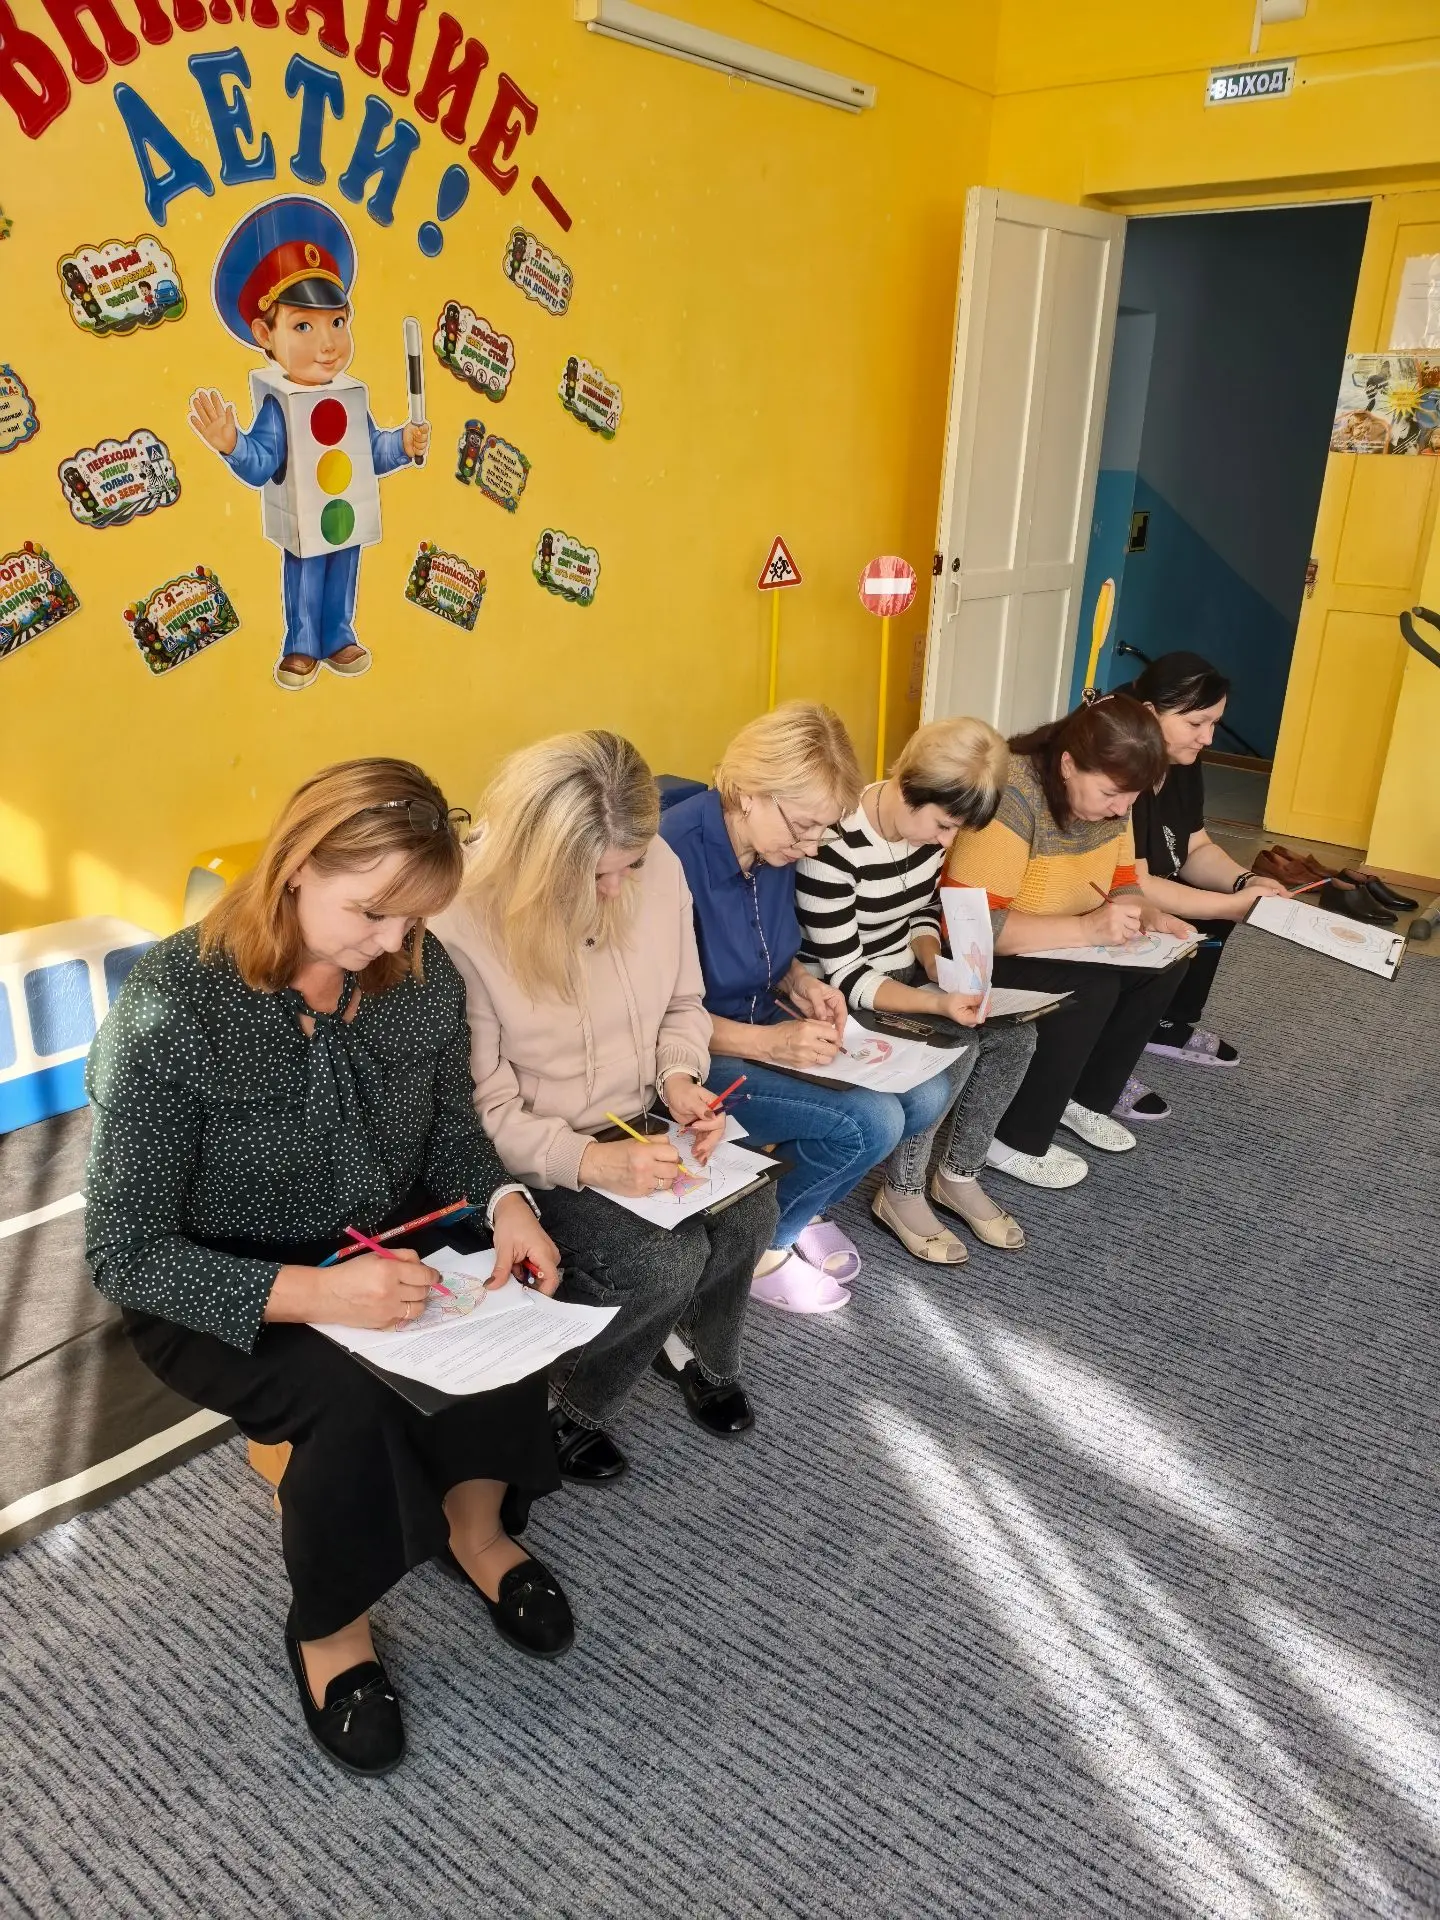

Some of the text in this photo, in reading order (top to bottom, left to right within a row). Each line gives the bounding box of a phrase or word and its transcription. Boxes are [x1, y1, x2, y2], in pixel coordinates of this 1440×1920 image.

[1211, 70, 1284, 100] ВЫХОД
[113, 46, 471, 258] ДЕТИ!
[535, 248, 542, 259] Я
[525, 265, 559, 297] ПОМОЩНИК
[530, 257, 560, 285] ГЛАВНЫЙ
[523, 275, 560, 310] НА ДОРОГЕ!
[86, 448, 138, 473] ПЕРЕХОДИ
[99, 462, 129, 481] УЛИЦУ
[100, 473, 135, 493] ТОЛЬКО
[102, 482, 147, 508] ПО ЗЕБРЕ
[432, 560, 478, 592] БЕЗОПАСНОСТЬ
[164, 592, 176, 607] Я
[166, 600, 214, 635] ПЕШЕХОД!
